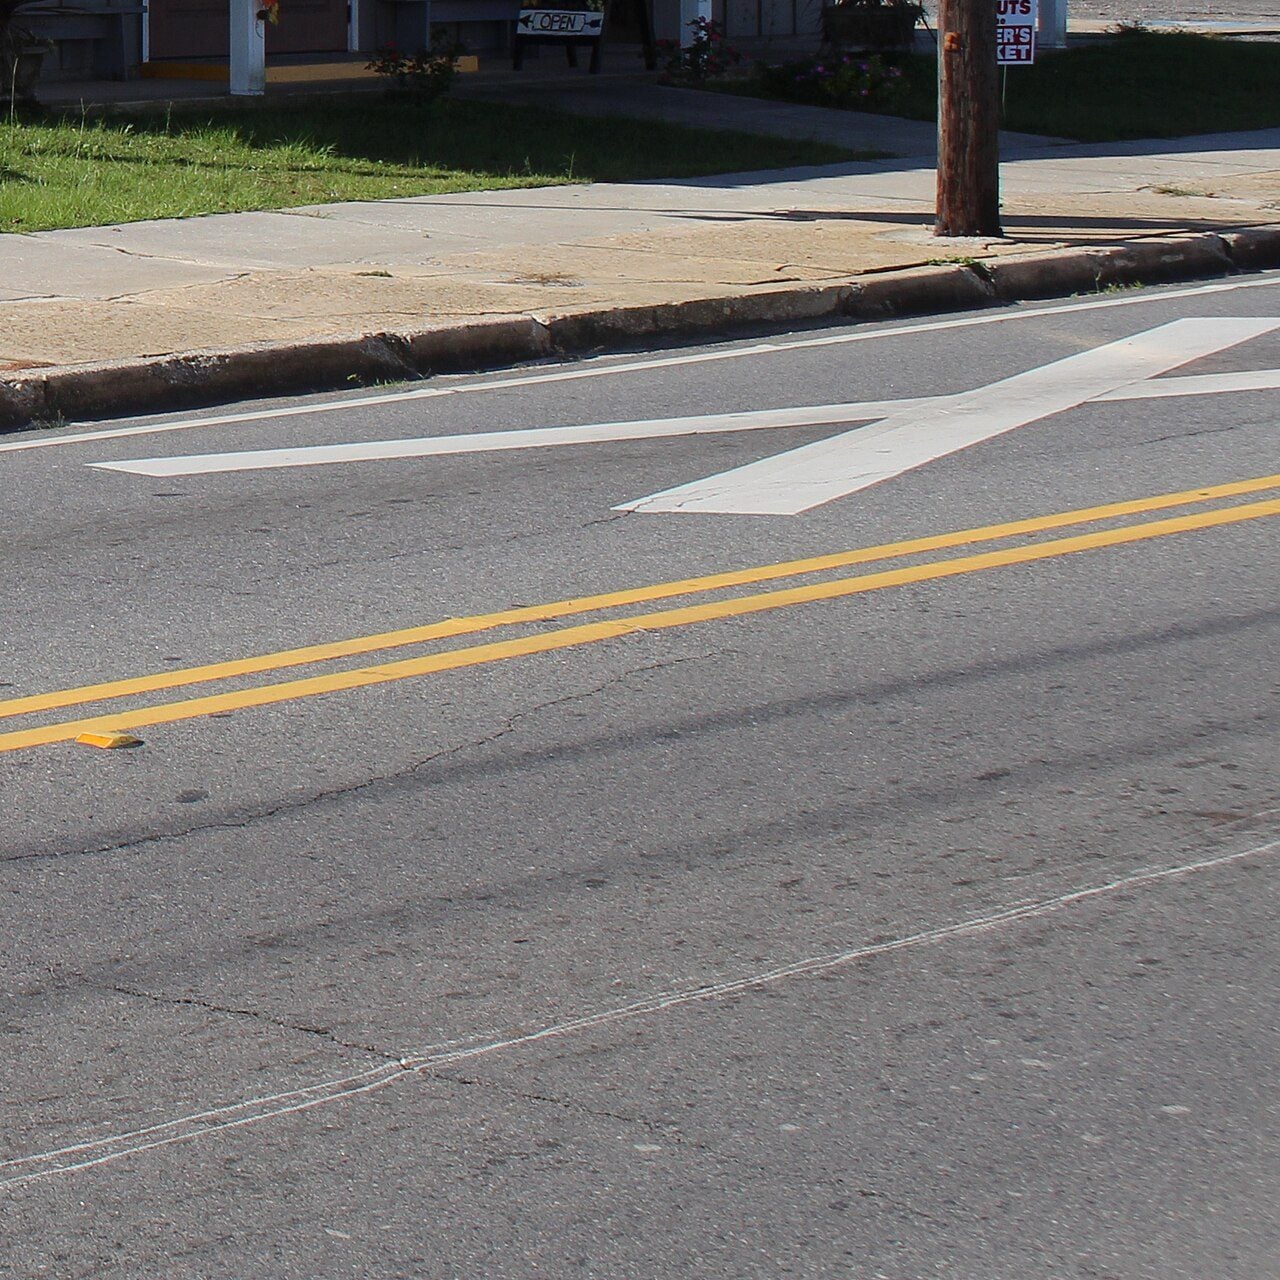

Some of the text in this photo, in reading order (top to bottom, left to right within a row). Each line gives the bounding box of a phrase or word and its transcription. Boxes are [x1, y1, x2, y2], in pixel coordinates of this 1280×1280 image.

[996, 0, 1032, 15] UTS
[540, 14, 576, 30] OPEN
[997, 27, 1031, 43] ER'S
[997, 45, 1030, 60] KET
